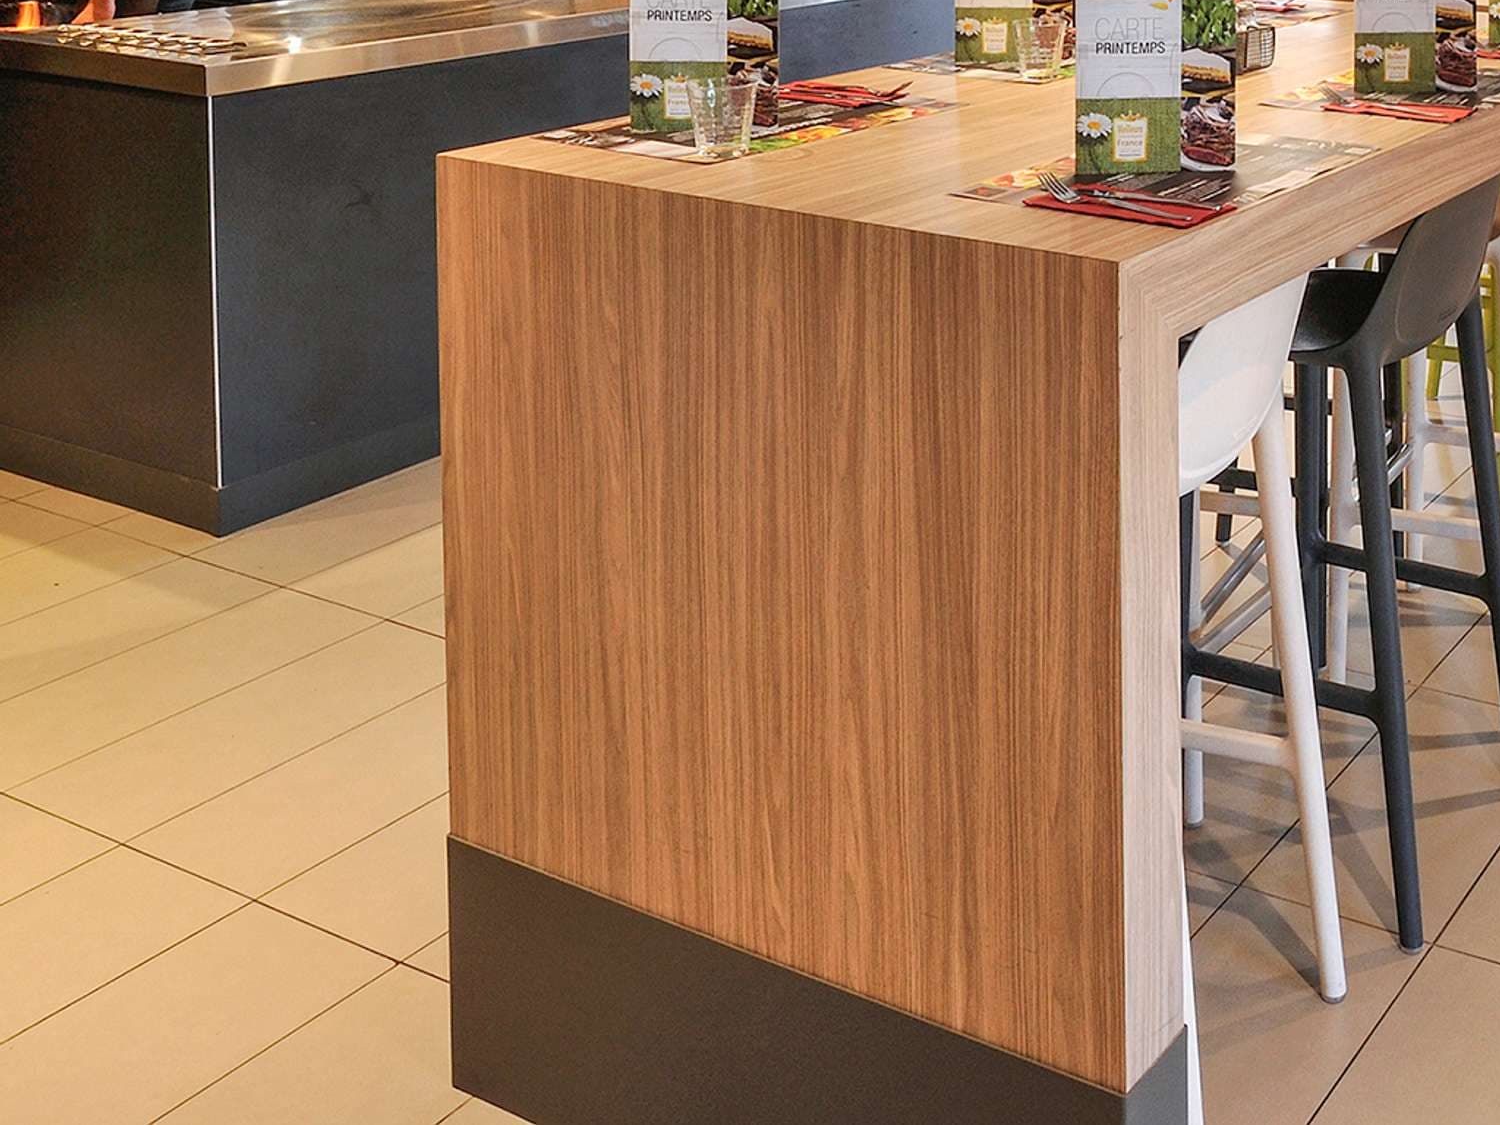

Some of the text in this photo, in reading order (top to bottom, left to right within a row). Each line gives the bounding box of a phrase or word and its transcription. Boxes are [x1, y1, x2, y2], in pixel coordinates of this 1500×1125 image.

[647, 9, 712, 22] PRINTEMPS
[1094, 17, 1164, 41] CARTE
[1095, 41, 1166, 55] PRINTEMPS
